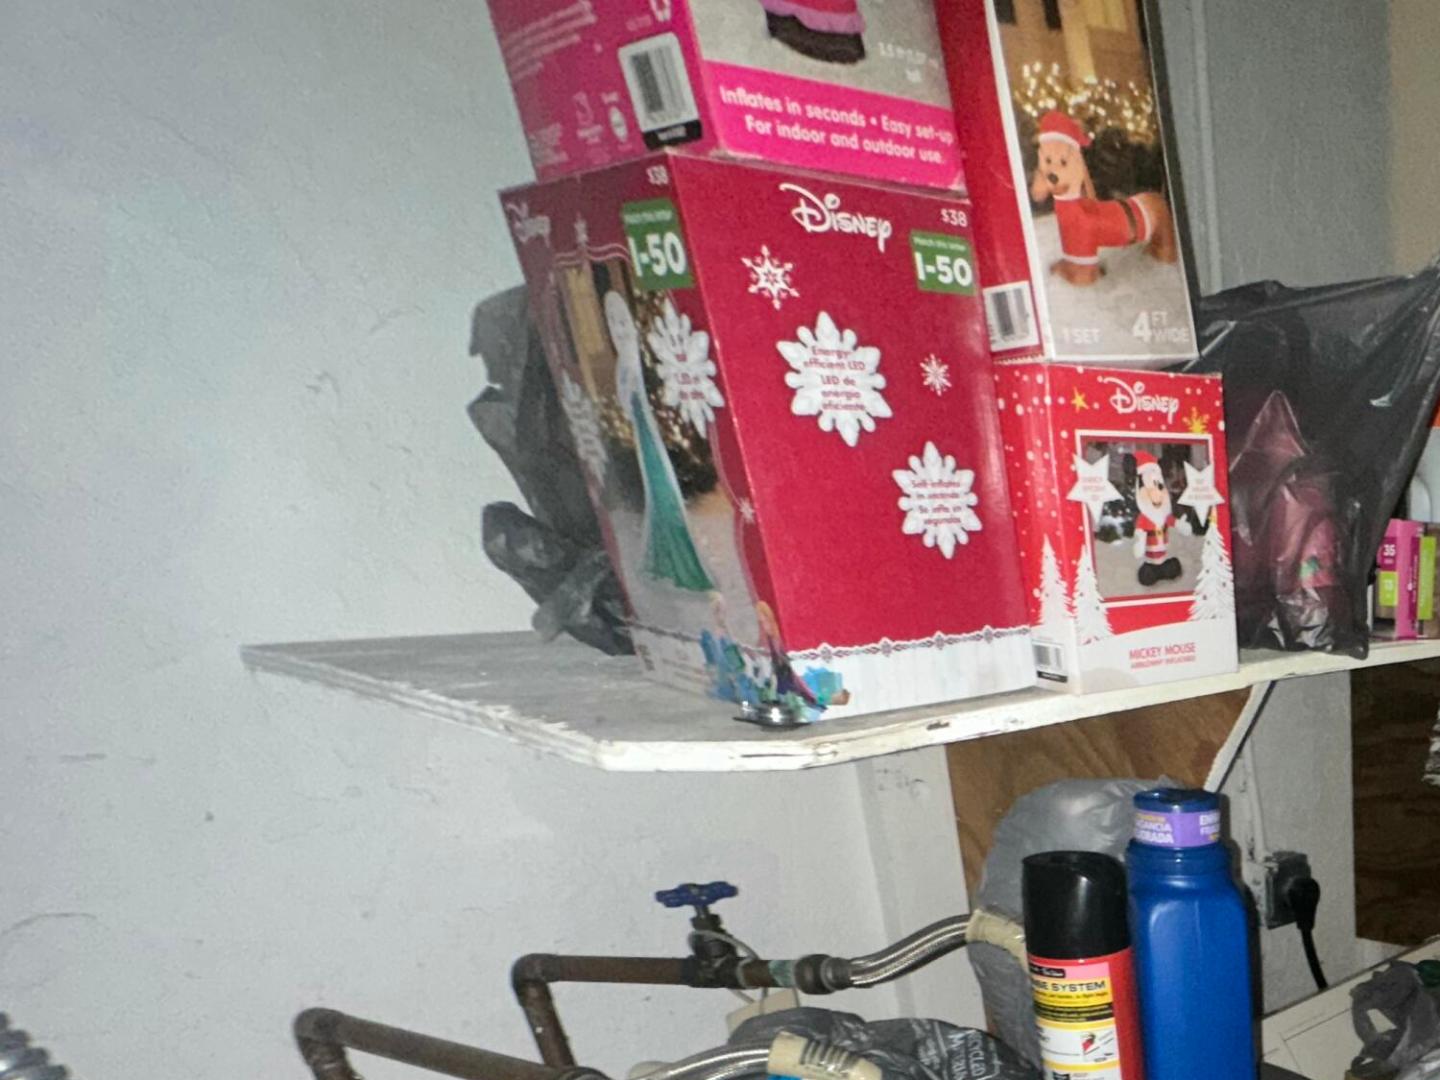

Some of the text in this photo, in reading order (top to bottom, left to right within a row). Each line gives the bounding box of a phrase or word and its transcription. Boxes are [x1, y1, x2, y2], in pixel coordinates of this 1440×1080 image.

[719, 85, 783, 113] Inflates
[785, 96, 802, 116] in
[805, 103, 866, 129] seconds
[881, 115, 912, 138] Easy
[744, 114, 772, 135] For
[776, 121, 826, 144] indoor
[830, 130, 859, 149] and
[863, 137, 916, 160] outdoor
[779, 182, 892, 253] Disney
[940, 208, 968, 228] $38
[1103, 377, 1179, 424] Disney
[1051, 980, 1106, 993] SYSTEM
